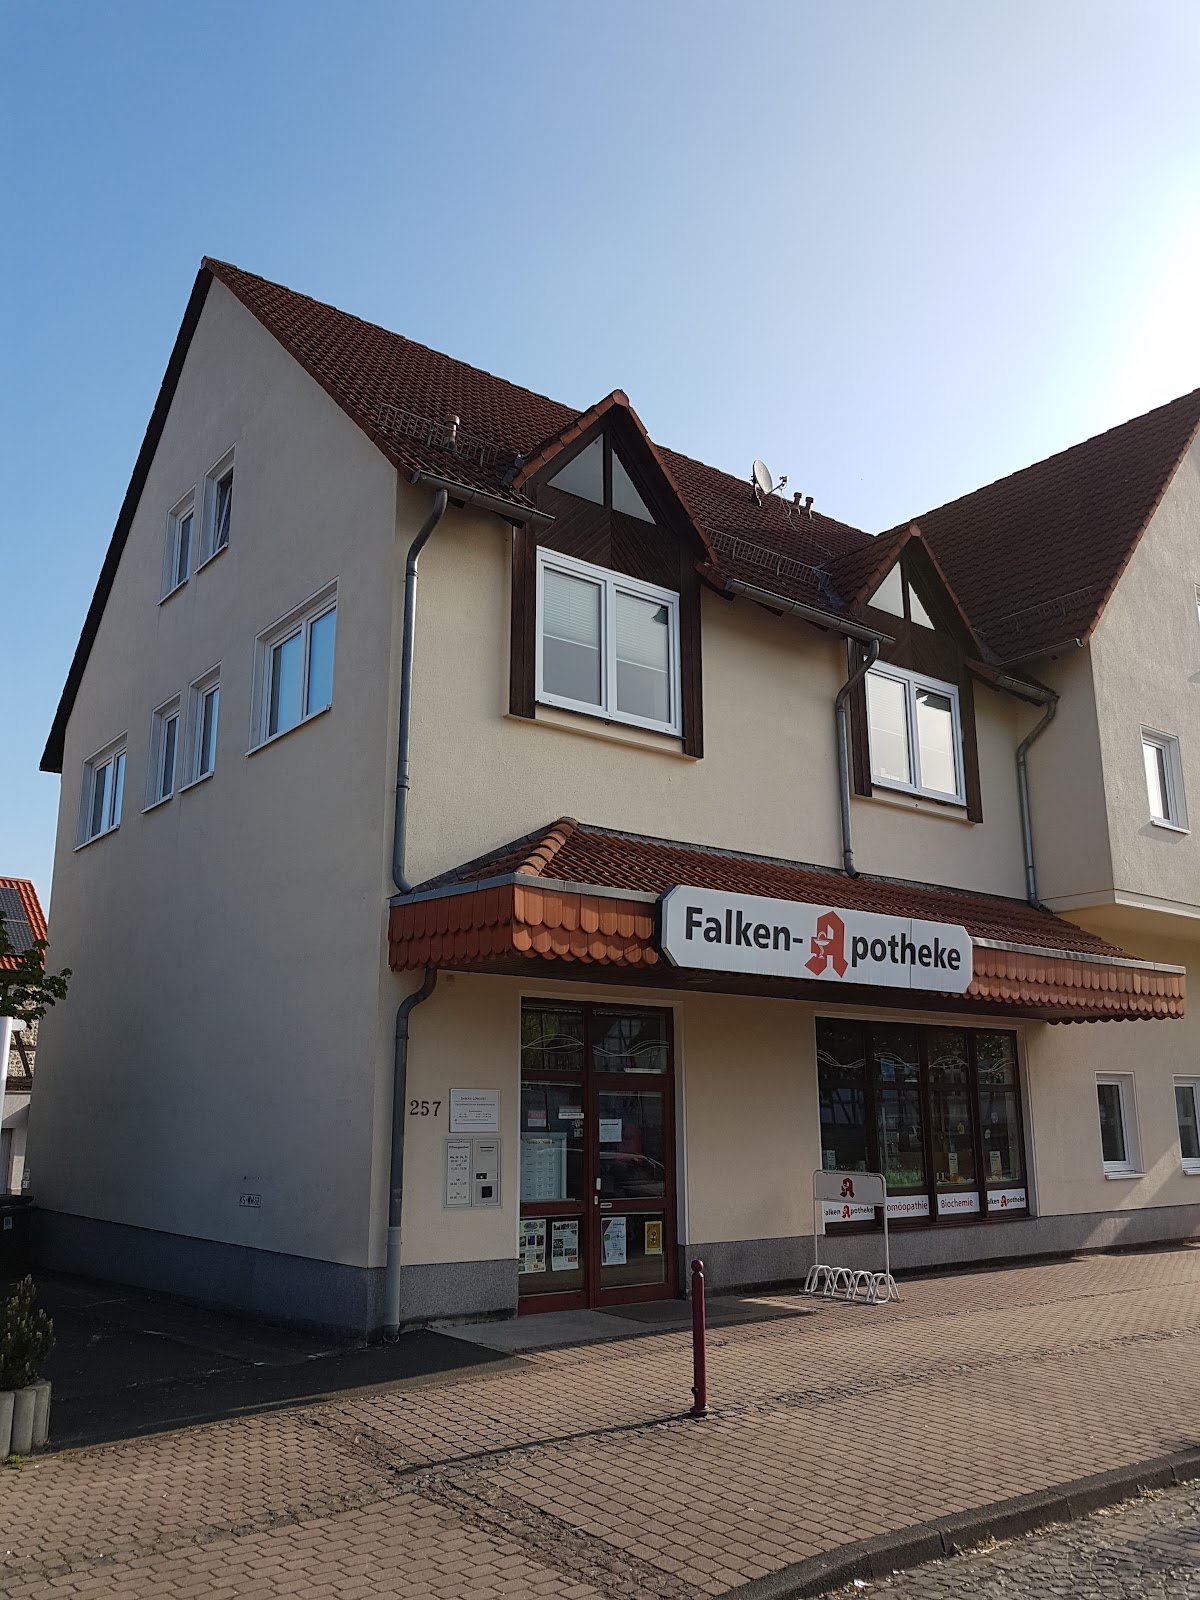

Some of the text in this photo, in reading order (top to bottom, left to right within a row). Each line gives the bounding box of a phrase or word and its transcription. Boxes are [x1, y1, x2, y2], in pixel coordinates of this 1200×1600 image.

[409, 1099, 442, 1117] 257
[886, 1200, 928, 1213] omöopathie
[941, 1197, 974, 1209] Biochemie
